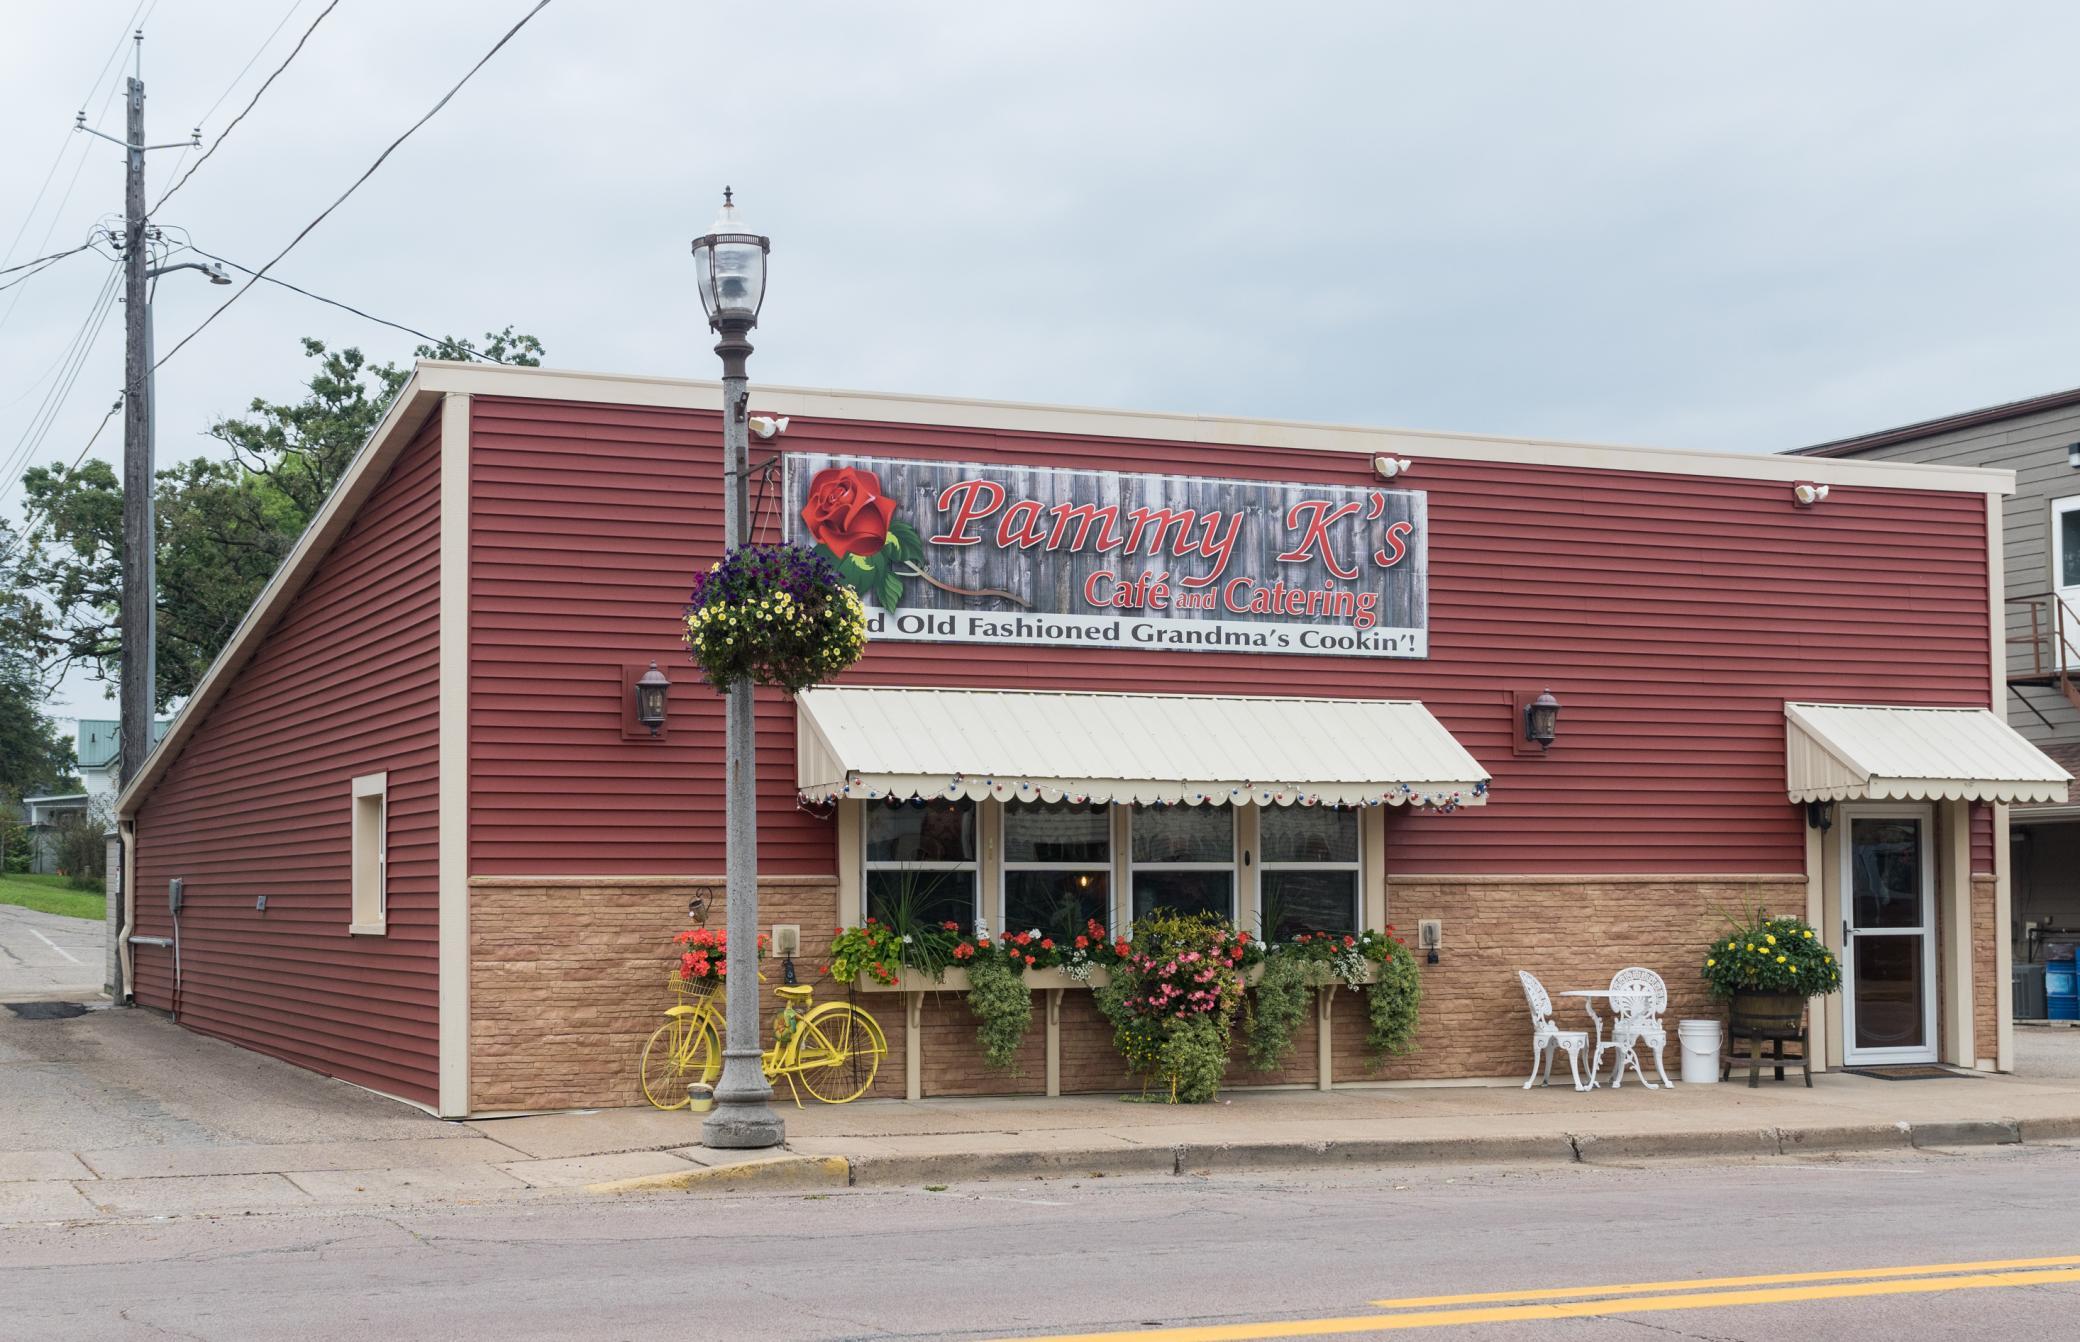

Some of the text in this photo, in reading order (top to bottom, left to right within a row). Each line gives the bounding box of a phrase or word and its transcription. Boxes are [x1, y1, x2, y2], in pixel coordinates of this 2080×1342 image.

[929, 479, 1413, 586] Pammy K's
[1084, 571, 1379, 629] Café and Catering
[896, 614, 956, 635] Old
[968, 618, 1120, 641] Fashioned
[1131, 623, 1290, 647] Grandma's
[1299, 631, 1416, 653] Cookin'!
